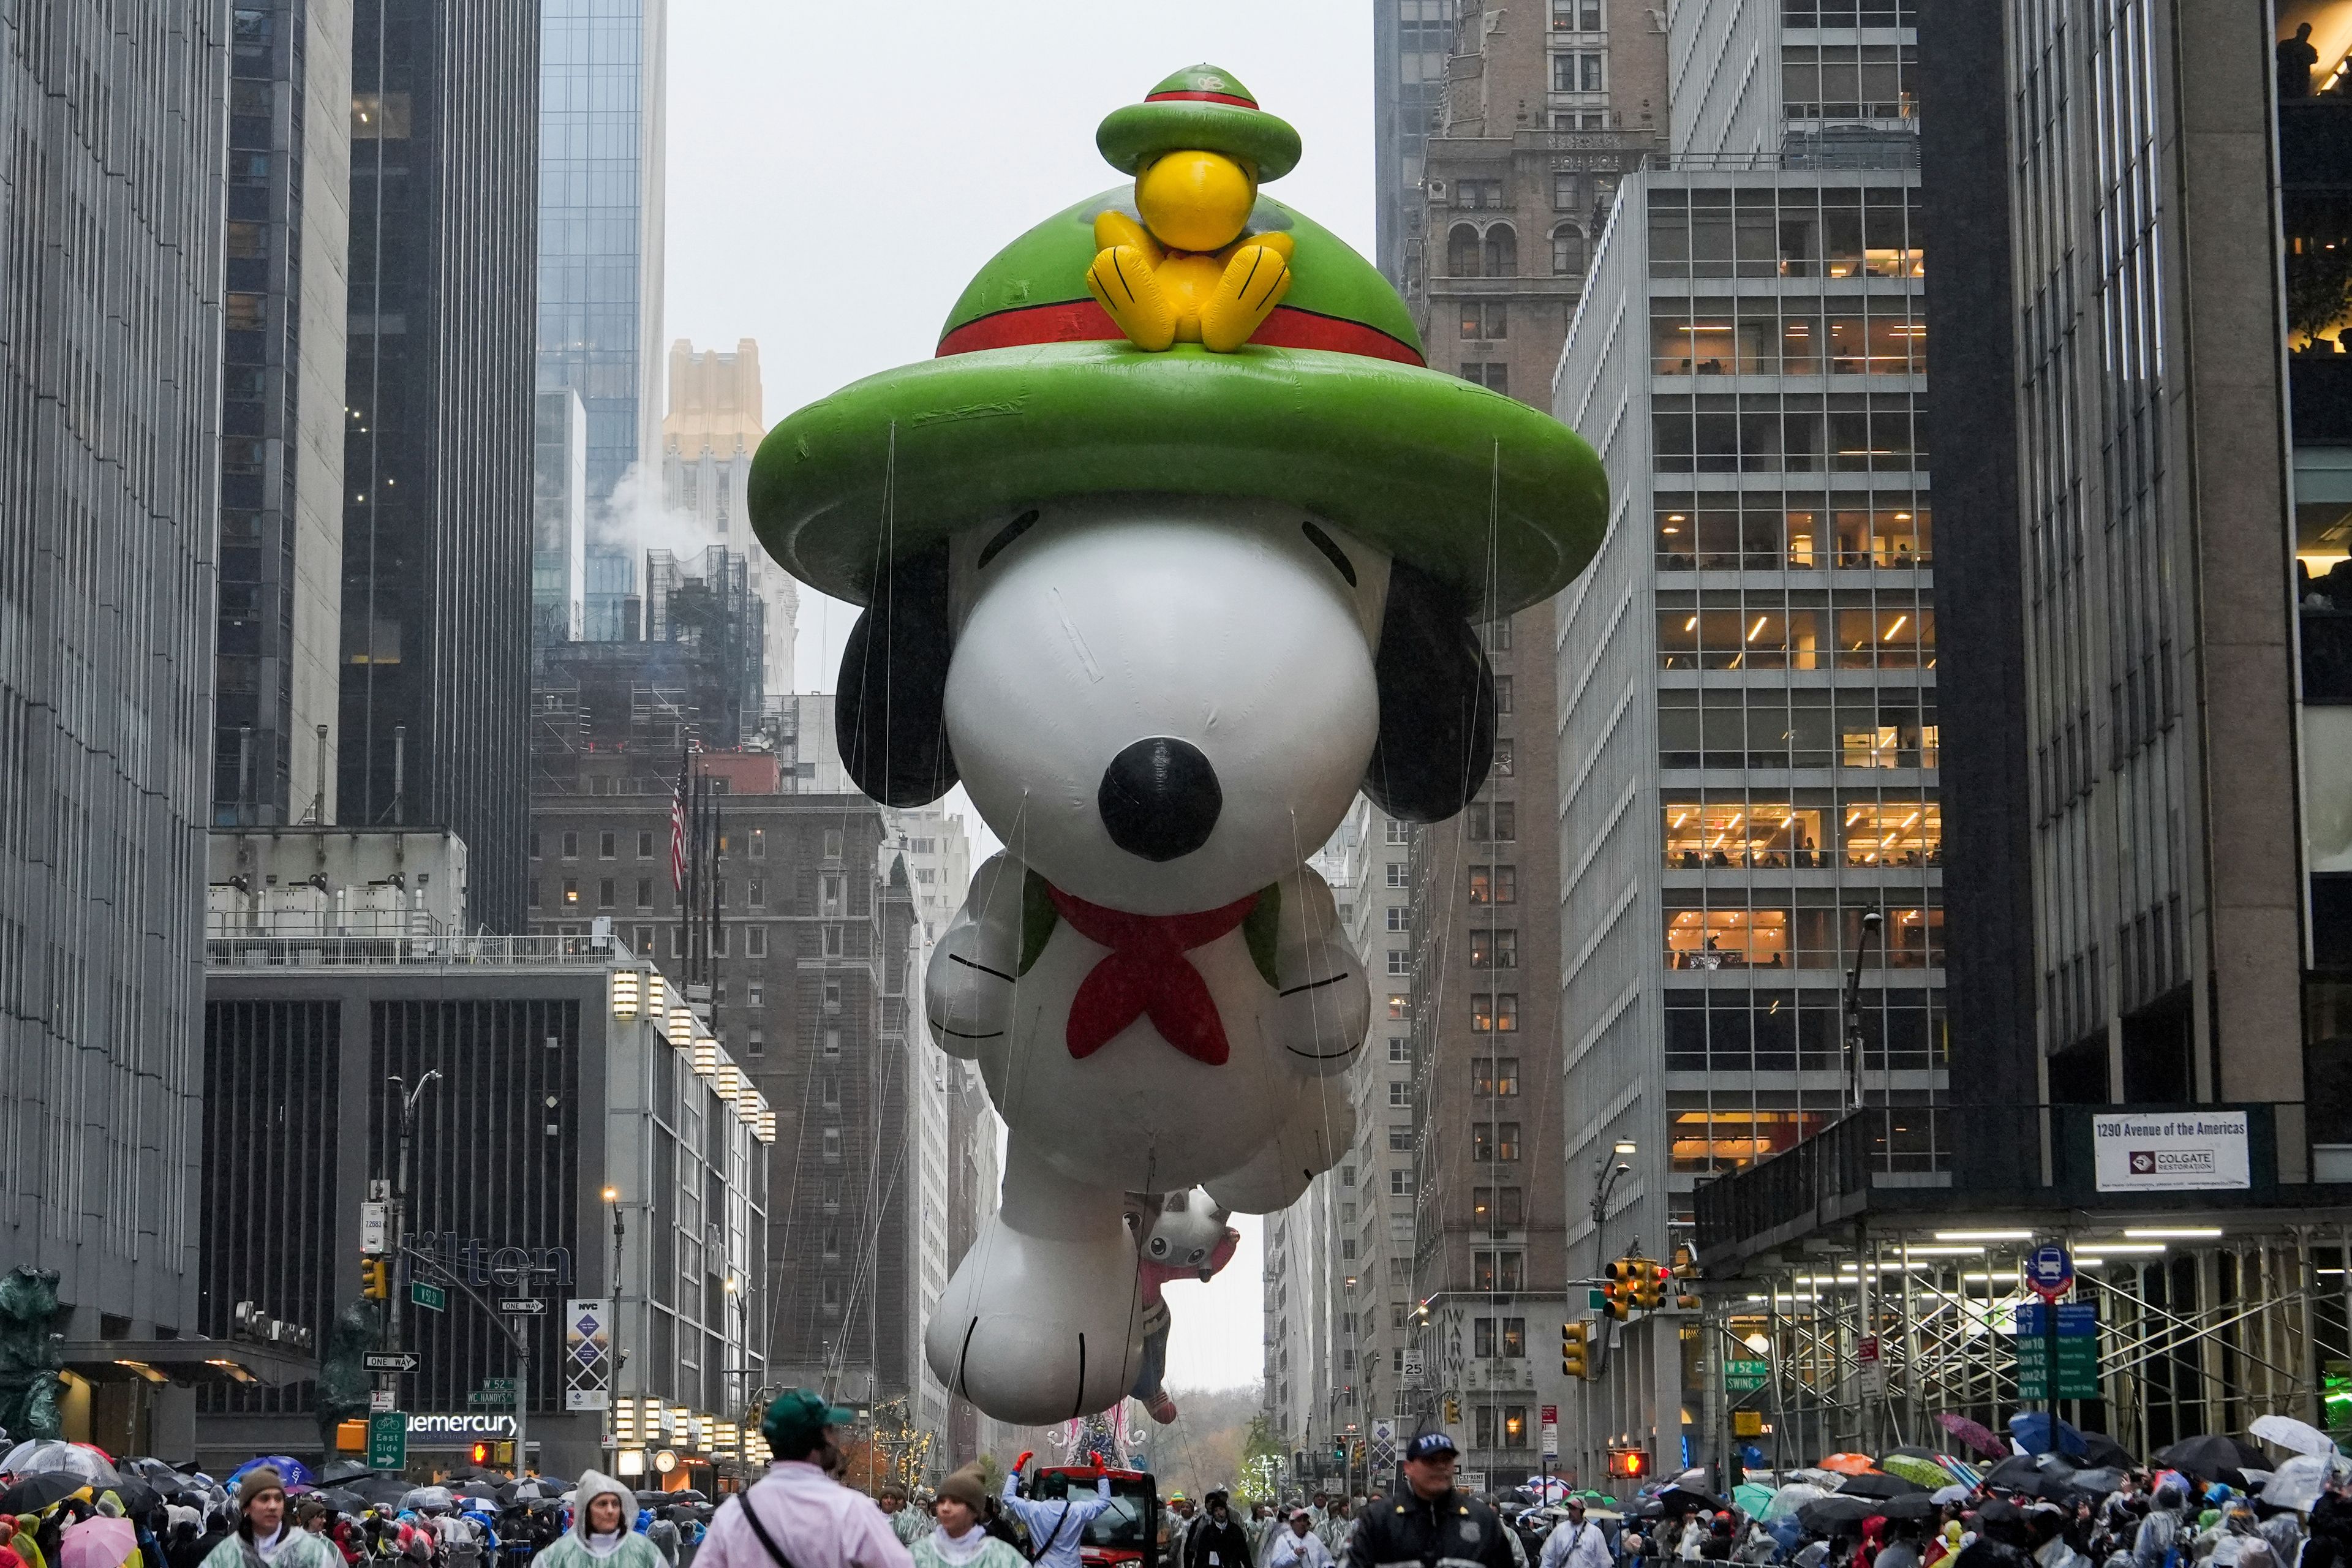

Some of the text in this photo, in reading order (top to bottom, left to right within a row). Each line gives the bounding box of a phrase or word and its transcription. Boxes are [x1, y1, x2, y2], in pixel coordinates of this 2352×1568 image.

[2097, 1121, 2245, 1137] 1290 Avenue of the Americas
[2158, 1153, 2211, 1163] COLGATE
[426, 1289, 431, 1303] 52
[2018, 1322, 2034, 1334] M7
[371, 1357, 412, 1366] ONE WAY
[1406, 1364, 1422, 1374] 25
[1728, 1362, 1735, 1372] W
[1739, 1362, 1752, 1373] 52
[484, 1380, 490, 1389] W
[494, 1380, 505, 1389] 52
[1728, 1378, 1754, 1389] SWING
[2019, 1386, 2041, 1397] MTA
[468, 1393, 477, 1403] WC
[481, 1393, 507, 1403] HANDYS
[376, 1433, 399, 1442] East
[376, 1444, 398, 1452] Side
